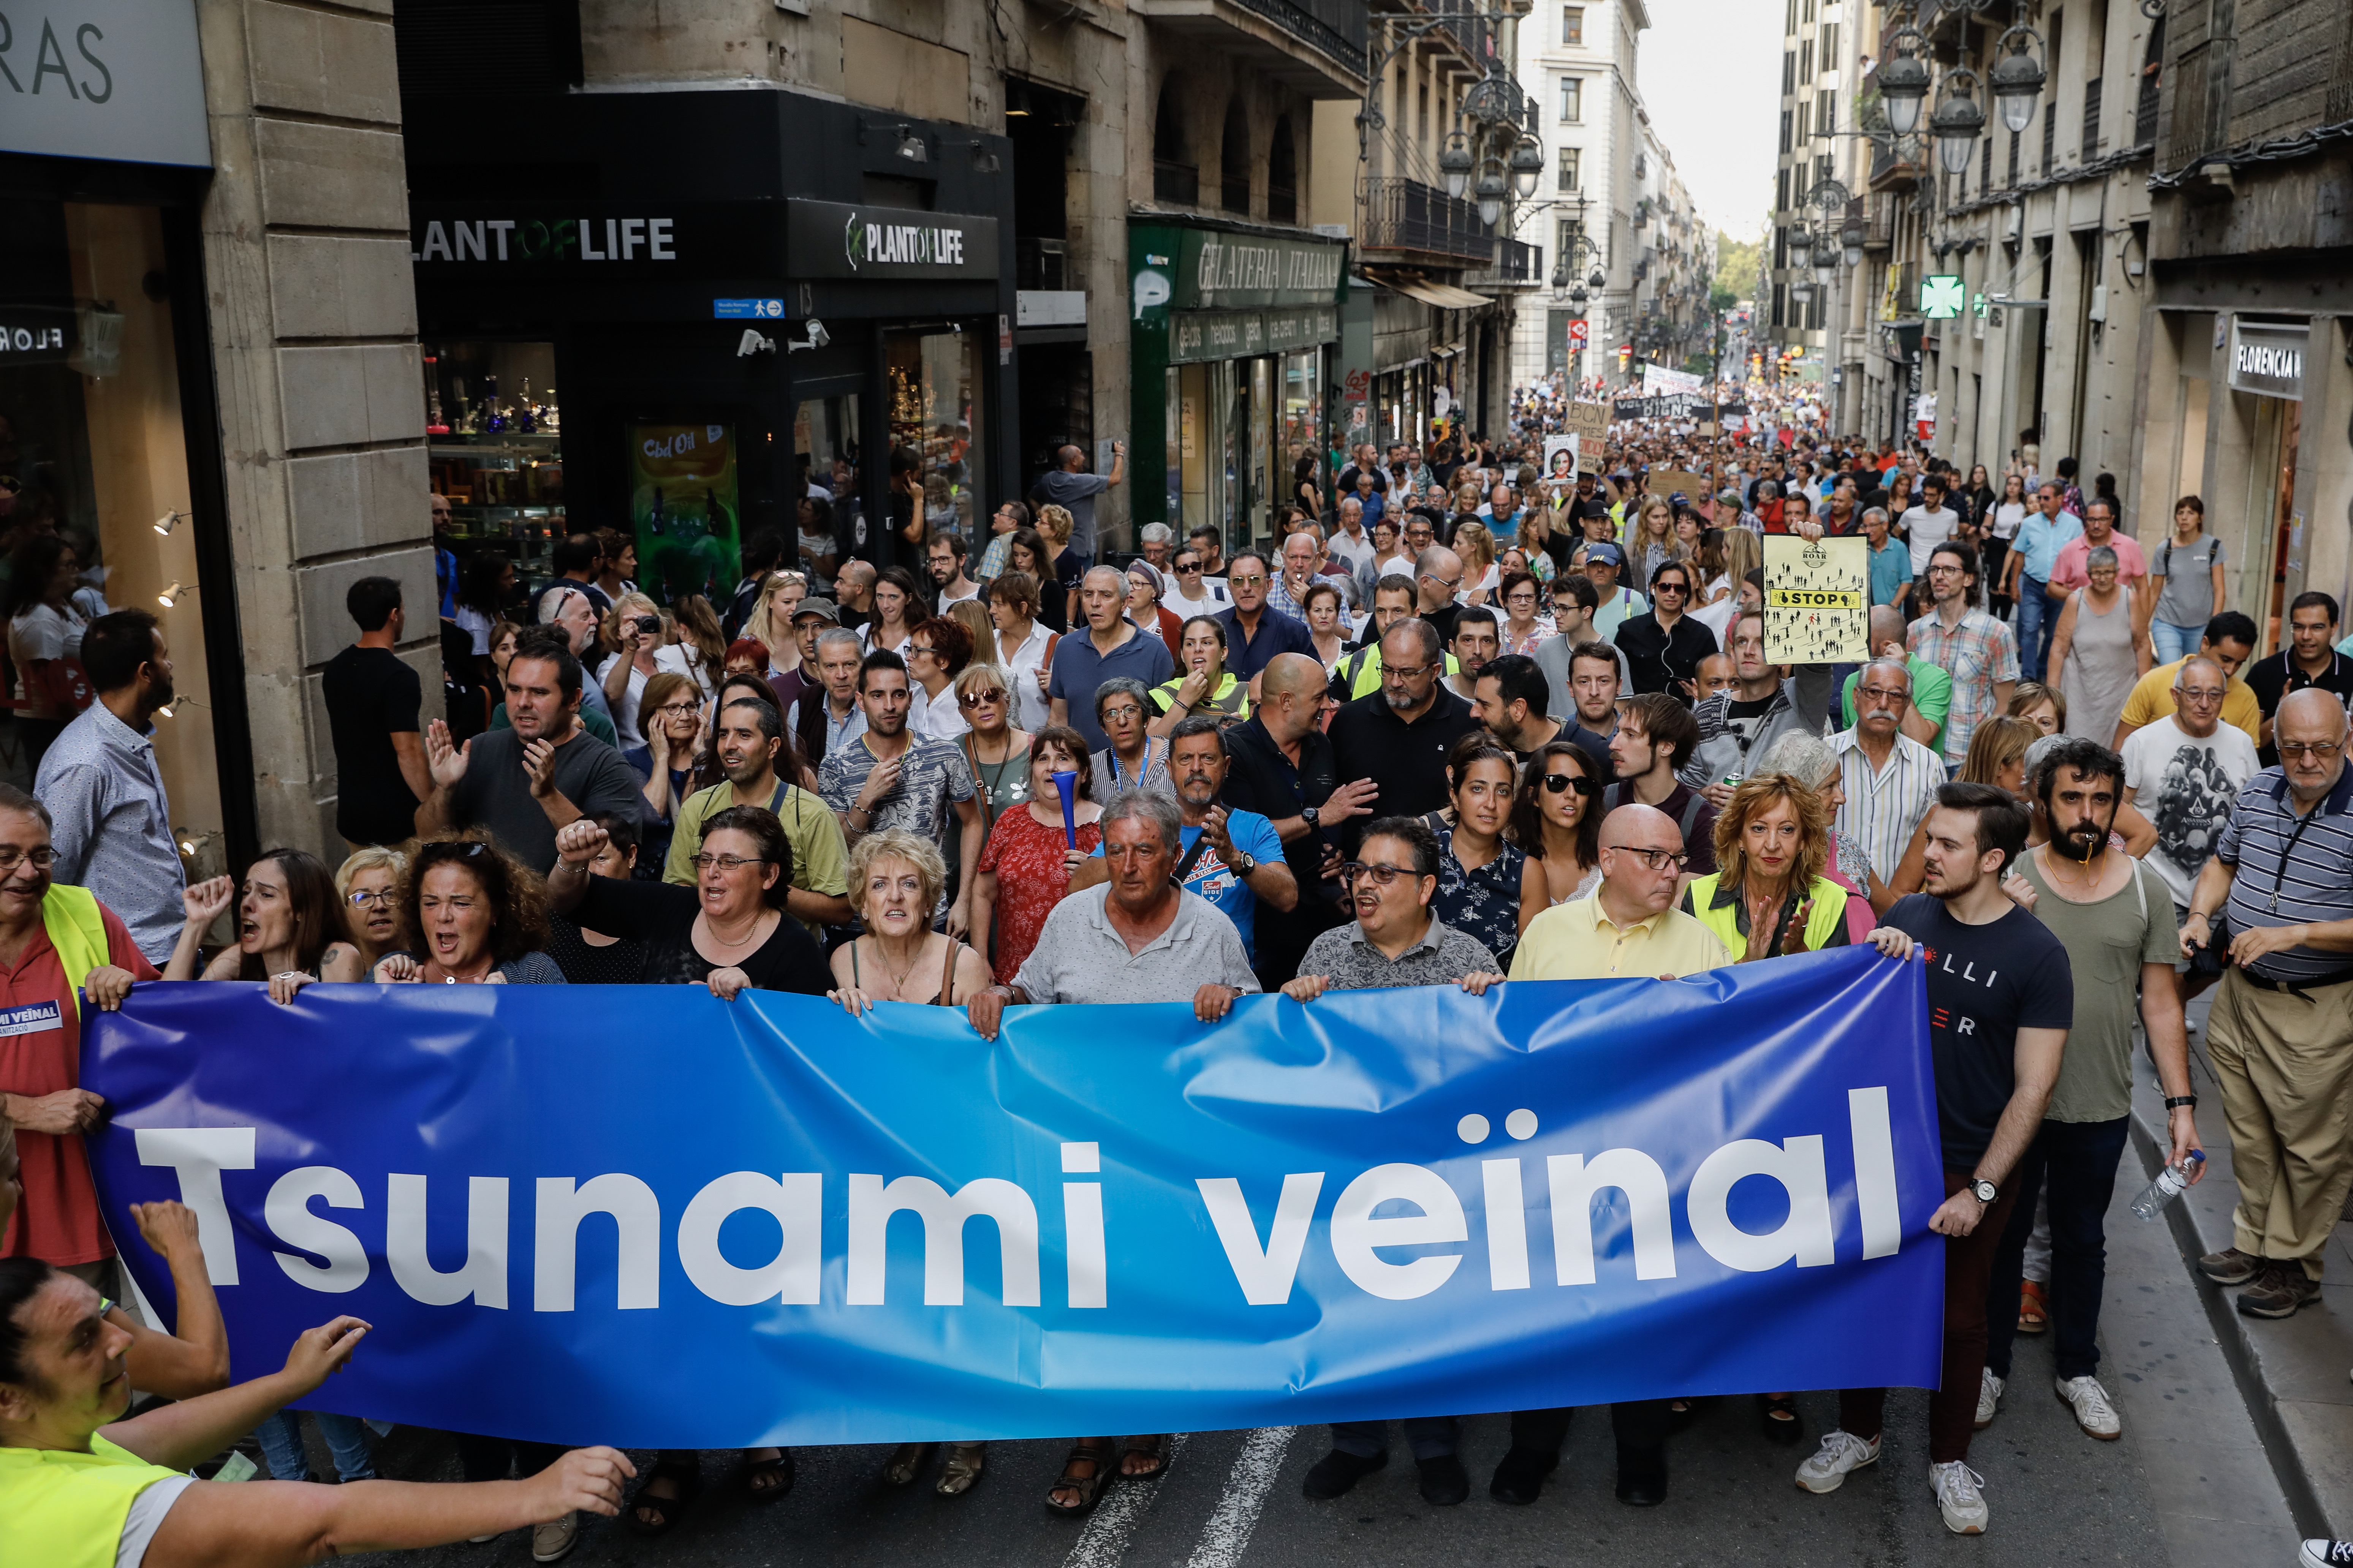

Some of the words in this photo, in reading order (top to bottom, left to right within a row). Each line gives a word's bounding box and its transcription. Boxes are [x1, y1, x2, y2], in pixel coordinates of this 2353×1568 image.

[411, 218, 676, 261] ANTOFLIFE
[1198, 242, 1279, 290] GELATERIA
[1287, 250, 1339, 289] ITALIANA
[1211, 317, 1236, 345] helados
[1570, 403, 1605, 424] BCN
[675, 432, 695, 454] Oil
[1791, 593, 1837, 605] STOP
[11, 1007, 57, 1023] VEÏNAL
[135, 1127, 1107, 1312] Tsunami
[1196, 1086, 1901, 1306] veïnal
